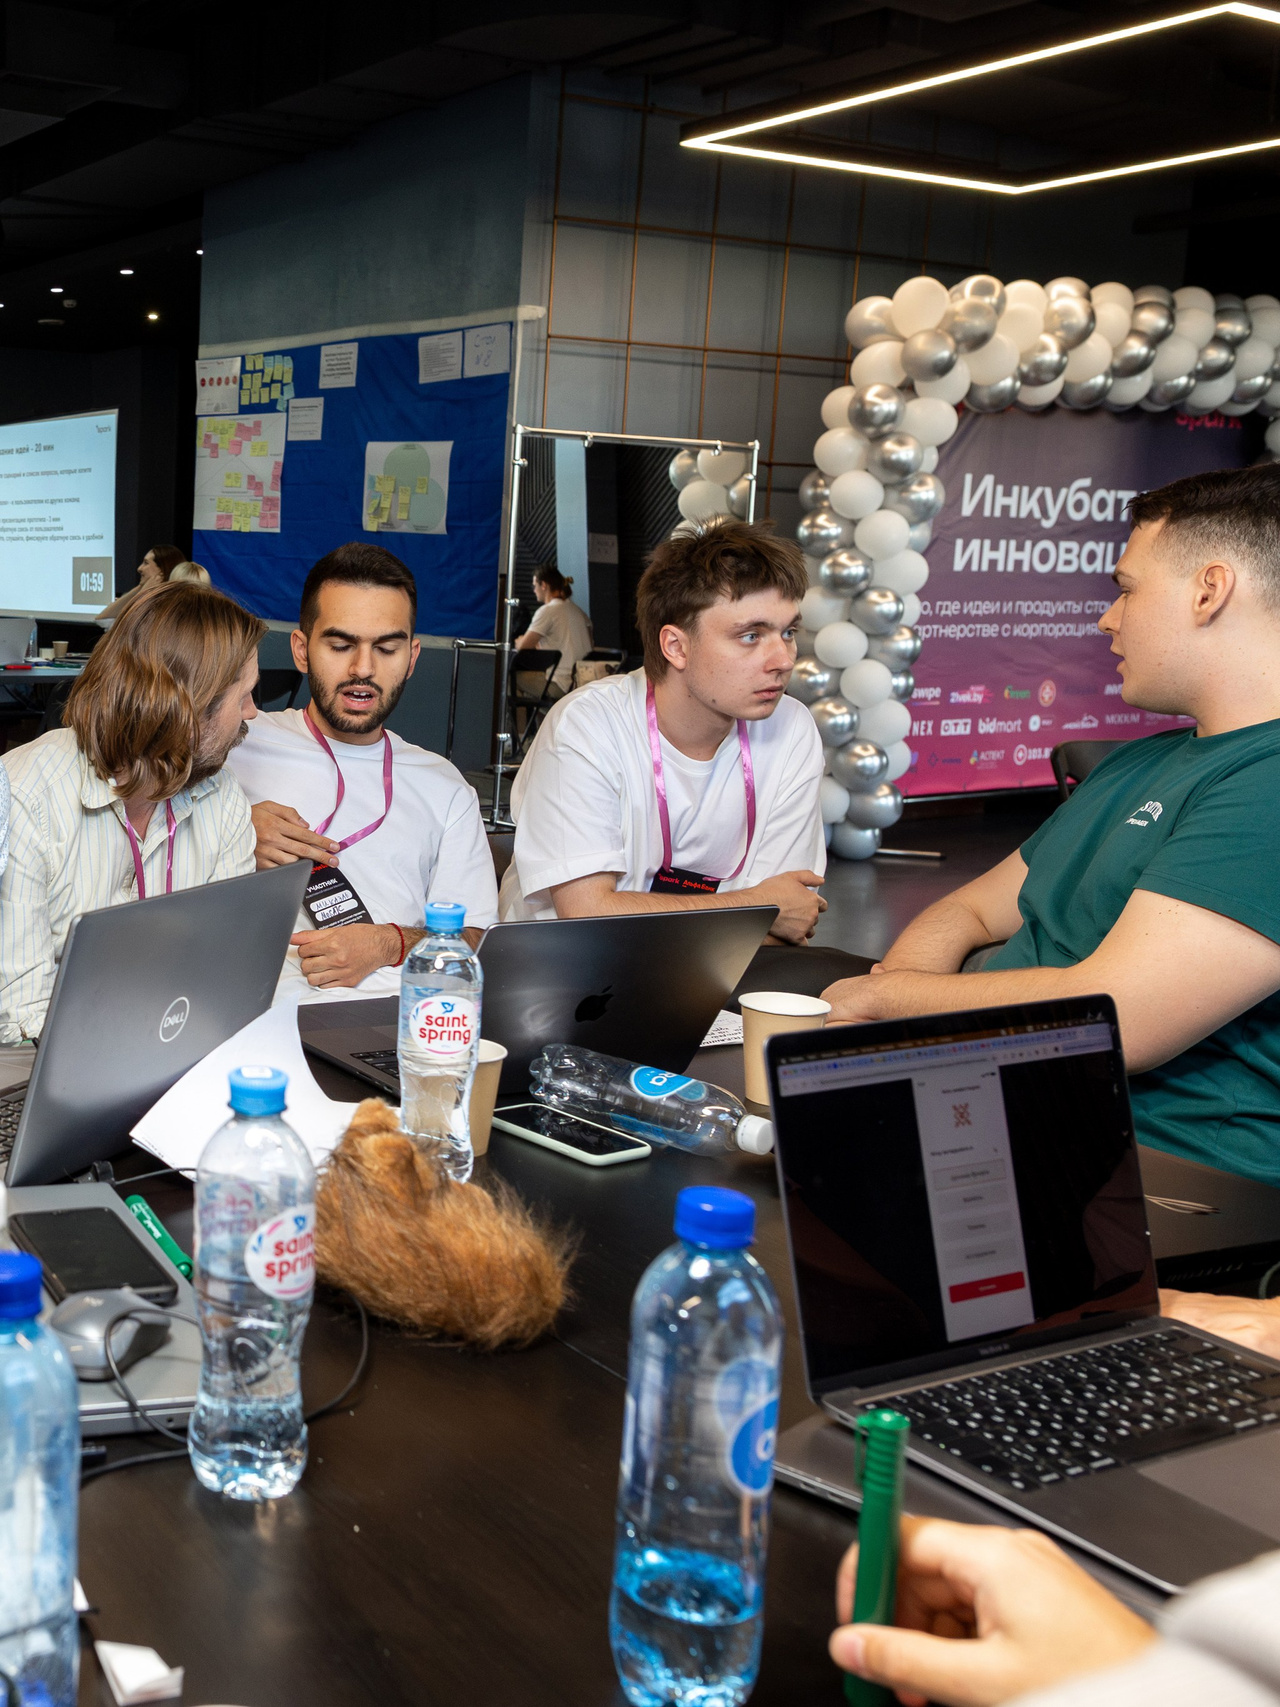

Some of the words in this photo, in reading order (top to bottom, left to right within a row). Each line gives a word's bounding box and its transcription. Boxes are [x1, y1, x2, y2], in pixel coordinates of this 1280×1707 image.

[35, 443, 42, 453] 20
[961, 473, 1134, 529] Инкубат
[80, 572, 104, 593] 01:59
[935, 601, 961, 617] где
[964, 600, 998, 616] идеи
[1000, 601, 1013, 615] и
[1014, 600, 1083, 617] продукты
[913, 623, 999, 640] артнерстве
[1001, 623, 1011, 637] с
[1013, 623, 1104, 639] корпорация
[911, 686, 942, 701] swipe
[912, 720, 934, 736] NEX
[978, 717, 1022, 734] bidmart
[163, 1012, 185, 1028] DELL
[425, 1014, 468, 1027] saint
[419, 1027, 471, 1045] spring
[274, 1232, 315, 1257] sain
[265, 1252, 315, 1283] sprin
